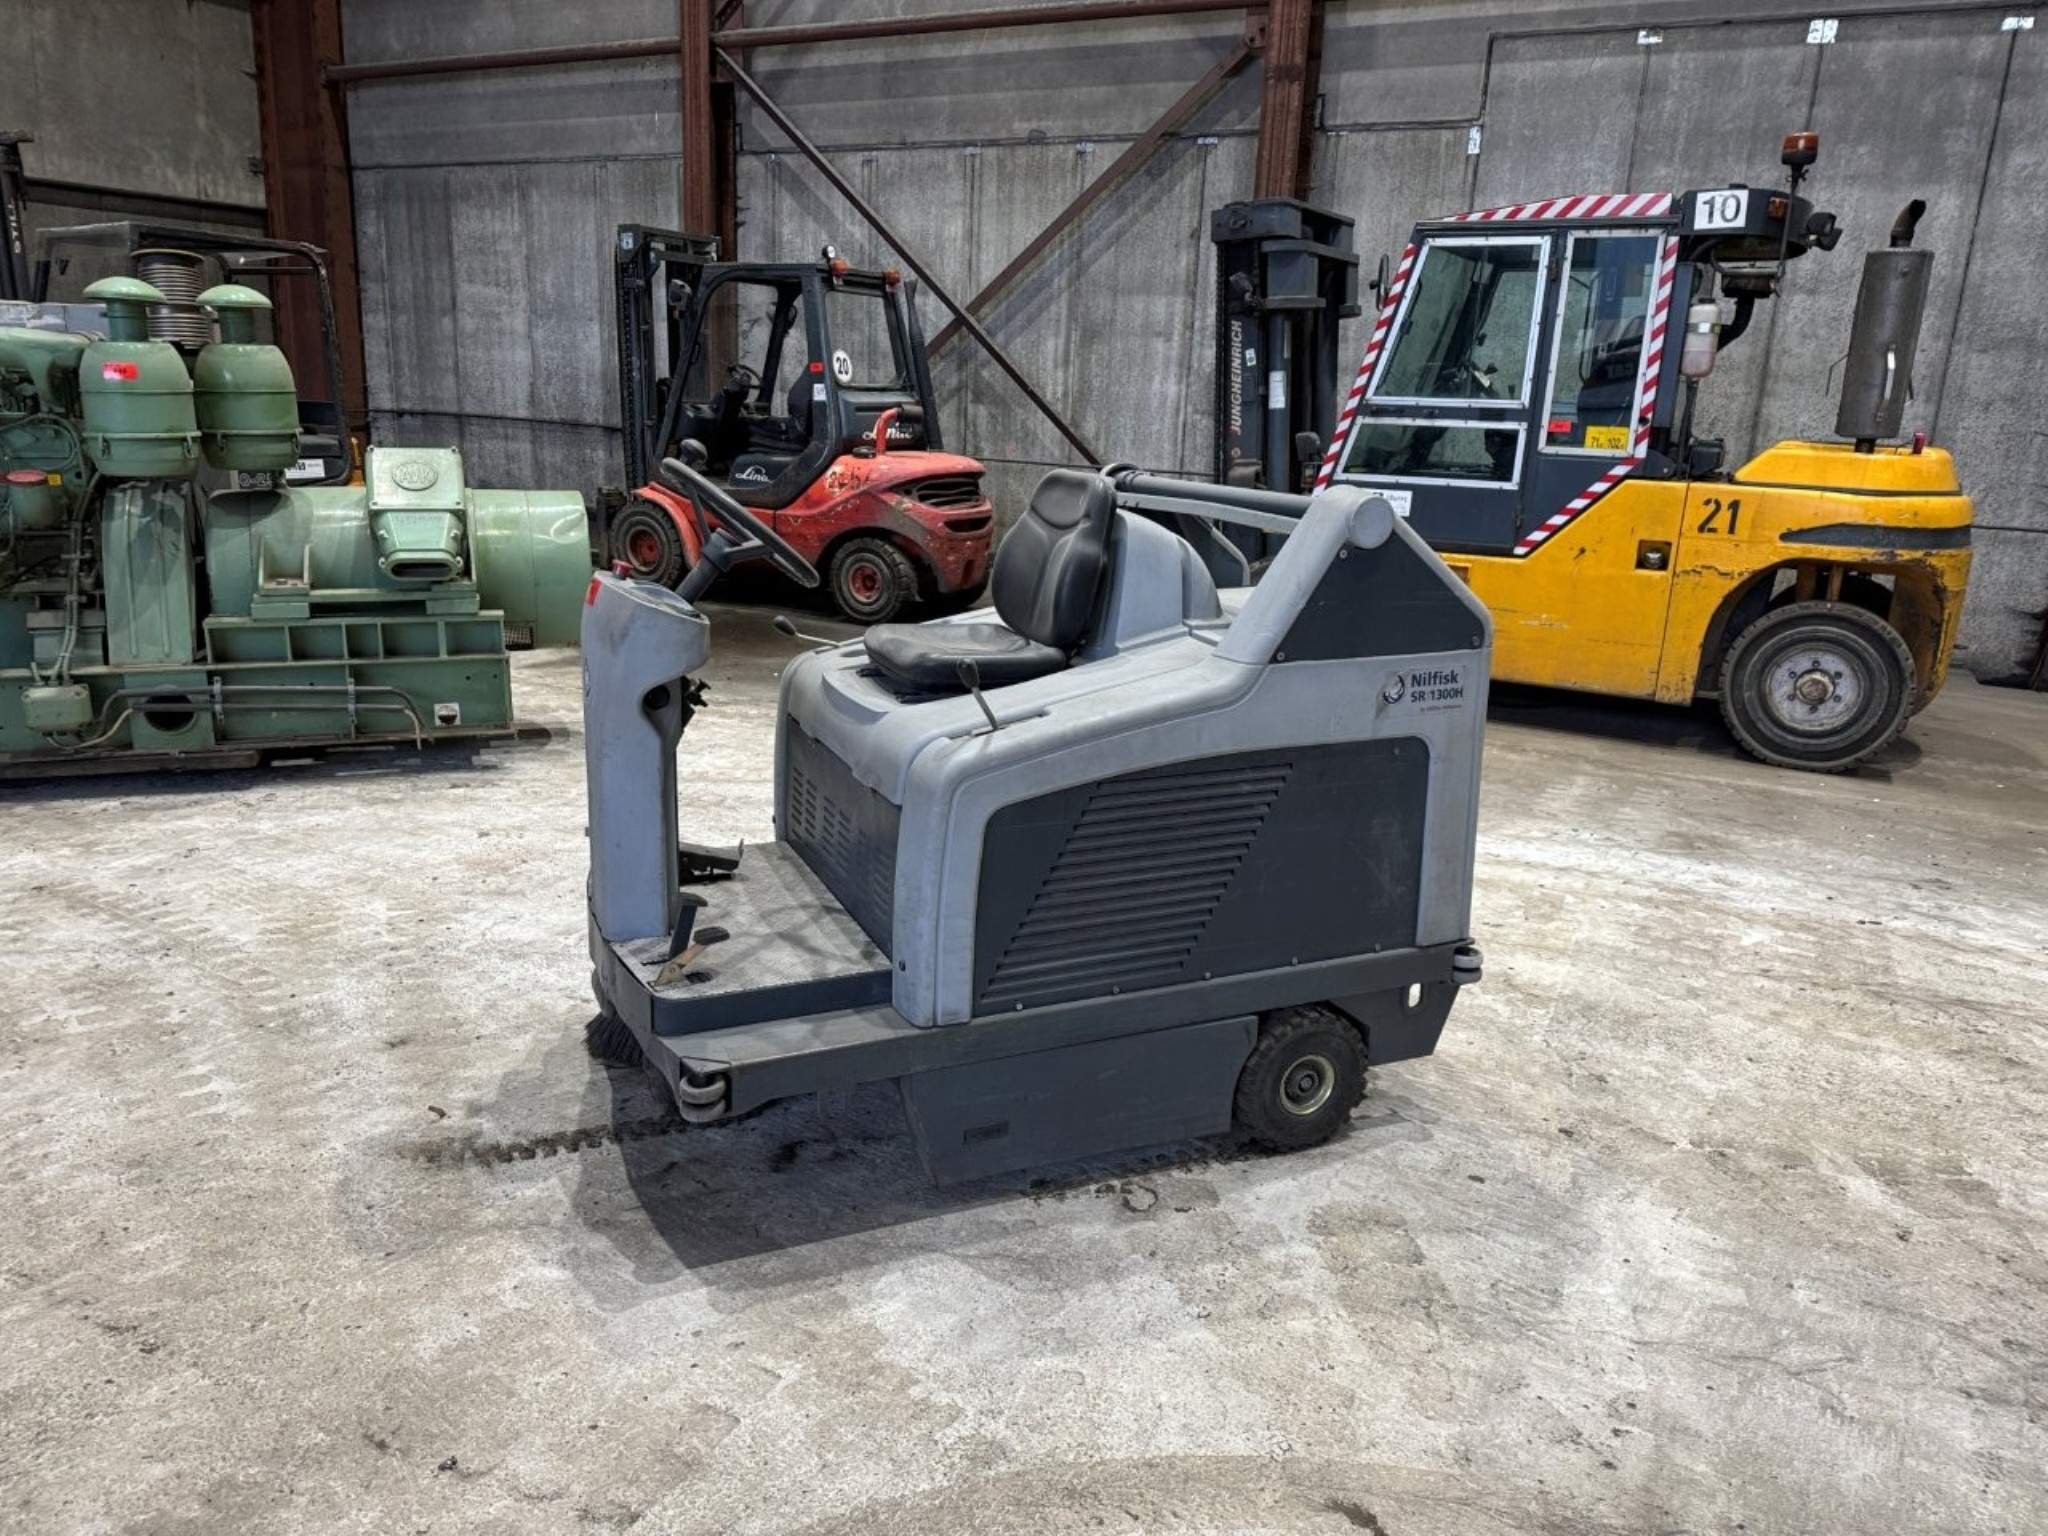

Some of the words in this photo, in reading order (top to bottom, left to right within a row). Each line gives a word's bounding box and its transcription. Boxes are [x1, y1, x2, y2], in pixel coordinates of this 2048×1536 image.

[1702, 194, 1742, 224] 10
[836, 356, 849, 375] 20
[1231, 319, 1242, 435] JUNGHEINRICH
[1697, 498, 1741, 535] 21
[1411, 670, 1459, 687] Nilfisk
[1411, 691, 1426, 703] SR
[1430, 687, 1463, 701] 1300H
